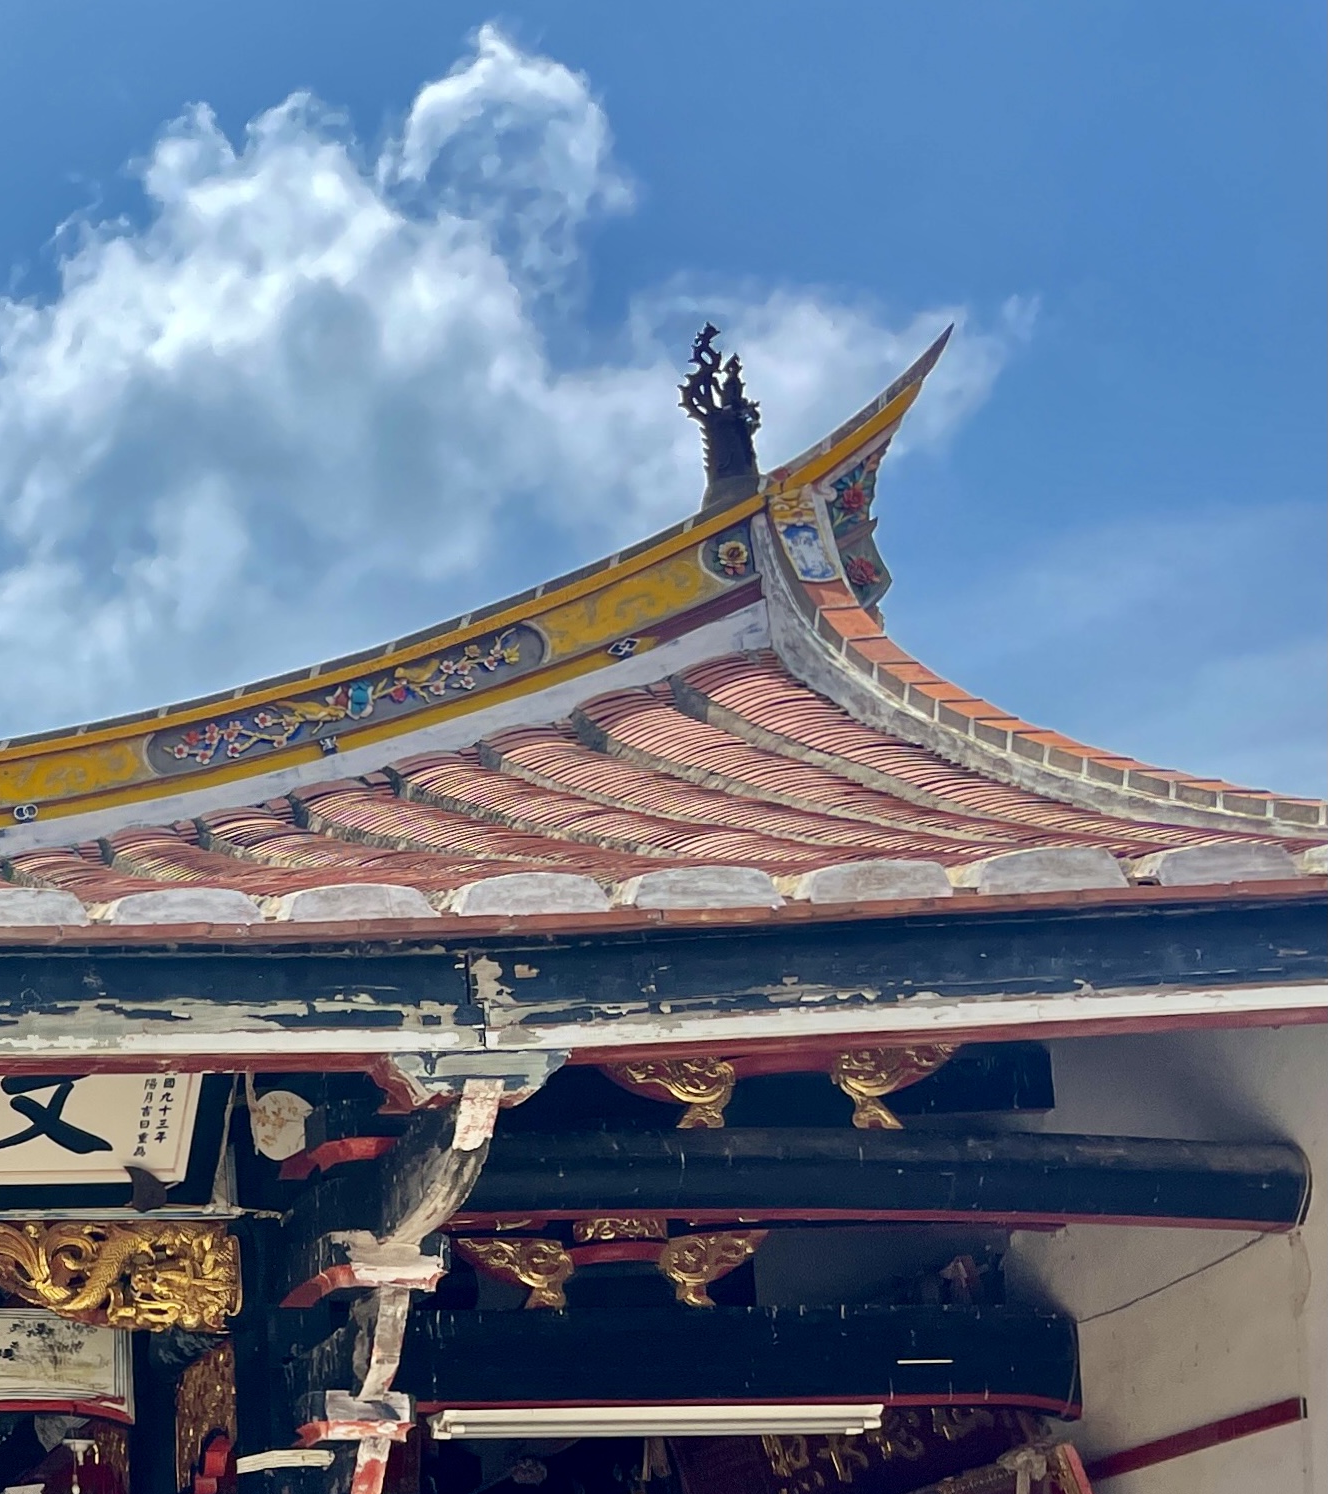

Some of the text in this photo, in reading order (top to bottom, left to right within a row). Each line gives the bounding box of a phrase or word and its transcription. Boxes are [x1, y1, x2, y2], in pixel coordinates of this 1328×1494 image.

[154, 1072, 177, 1143] 國九十三年
